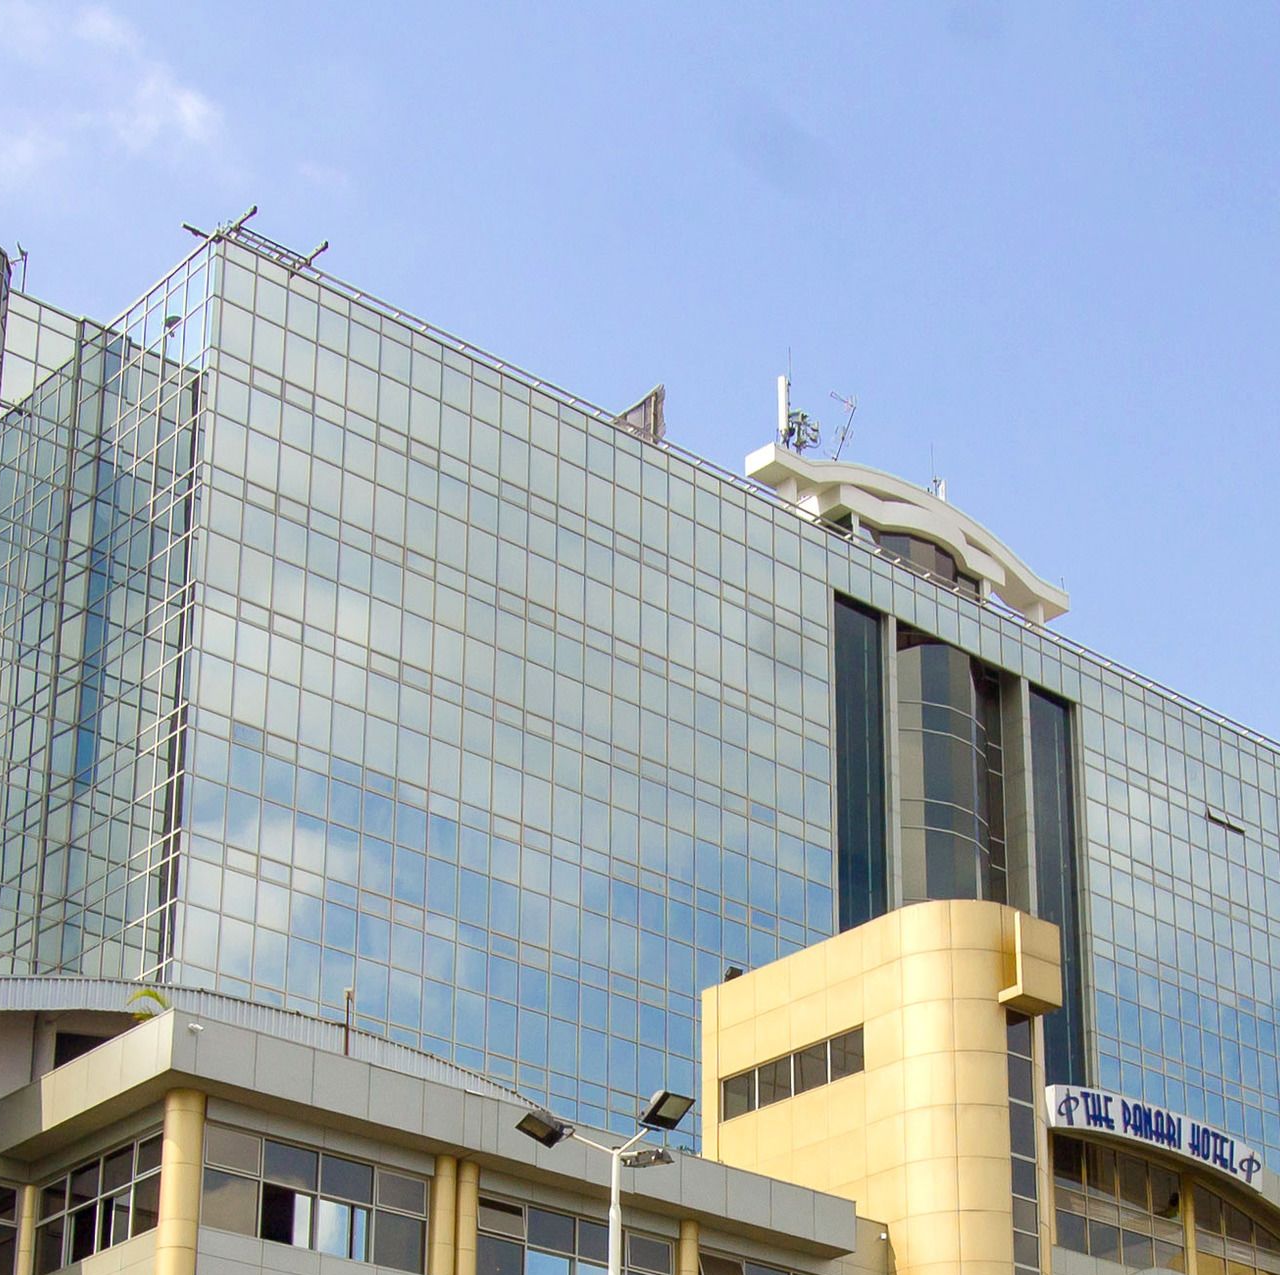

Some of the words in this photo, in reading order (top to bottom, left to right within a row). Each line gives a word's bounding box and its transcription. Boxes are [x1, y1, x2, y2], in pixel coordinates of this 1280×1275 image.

[1080, 1091, 1115, 1131] THE
[1121, 1099, 1182, 1150] PANARI
[1188, 1123, 1239, 1174] HOTEL
